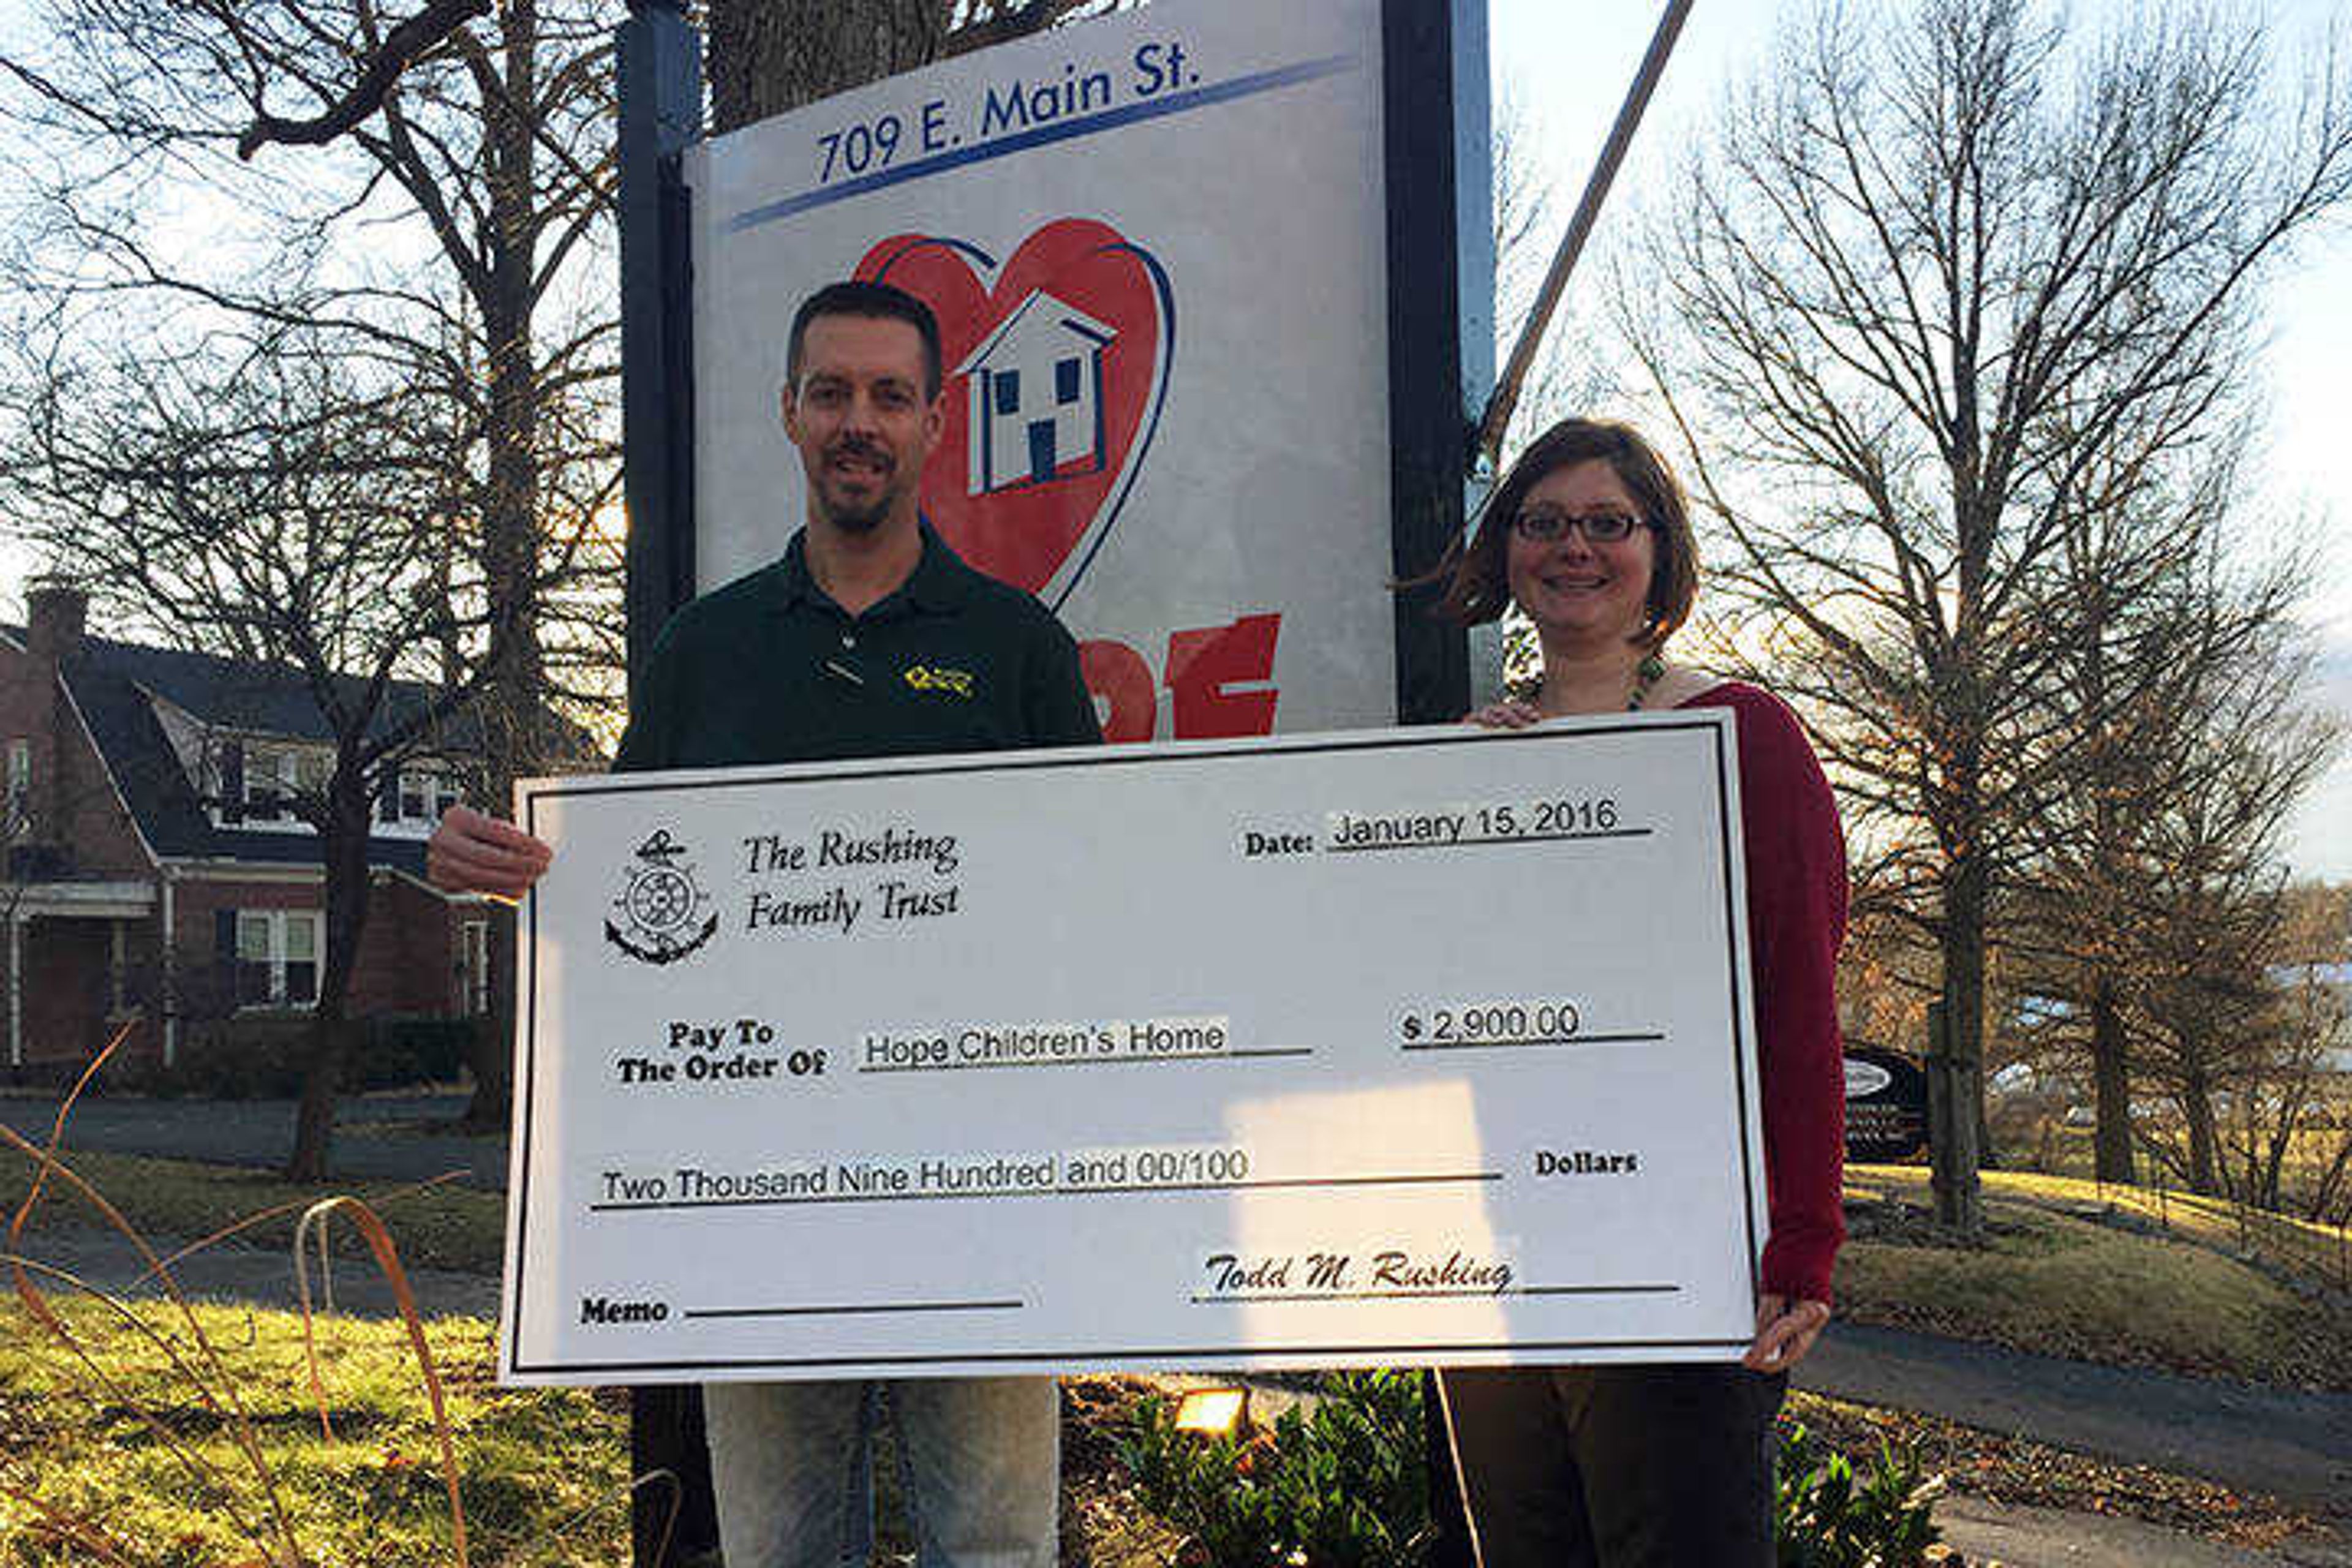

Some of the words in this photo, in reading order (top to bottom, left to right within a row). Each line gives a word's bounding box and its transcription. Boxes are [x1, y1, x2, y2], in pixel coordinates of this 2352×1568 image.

[818, 116, 902, 184] 709
[921, 102, 962, 151] E.
[981, 65, 1110, 135] Main
[1134, 44, 1200, 96] St.
[1245, 834, 1314, 856] Date:
[1333, 813, 1465, 845] January
[1477, 806, 1526, 835] 15,
[1534, 799, 1618, 832] 2016
[742, 835, 807, 874] The
[819, 829, 959, 873] Rushing
[747, 889, 861, 933] Family
[877, 881, 960, 920] Trust
[670, 1022, 725, 1052] Pay
[735, 1020, 773, 1043] To
[865, 1036, 949, 1067] Hope
[957, 1024, 1115, 1061] Children's
[1129, 1022, 1225, 1052] Home
[1403, 1013, 1421, 1041] $
[1432, 1003, 1580, 1041] 2,900.00
[617, 1057, 676, 1084] The
[684, 1053, 777, 1079] Order
[786, 1050, 827, 1075] Of
[603, 1171, 666, 1200] Two
[675, 1164, 829, 1199] Thousand
[838, 1162, 909, 1193] Nine
[919, 1155, 1055, 1189] Hundred
[1066, 1153, 1127, 1185] and
[1135, 1148, 1250, 1183] 00/100
[1535, 1150, 1638, 1175] Dollars
[1205, 1254, 1291, 1292] Todd
[1306, 1252, 1356, 1287] M.
[1371, 1248, 1514, 1295] Rushing
[581, 1297, 669, 1324] Memo
